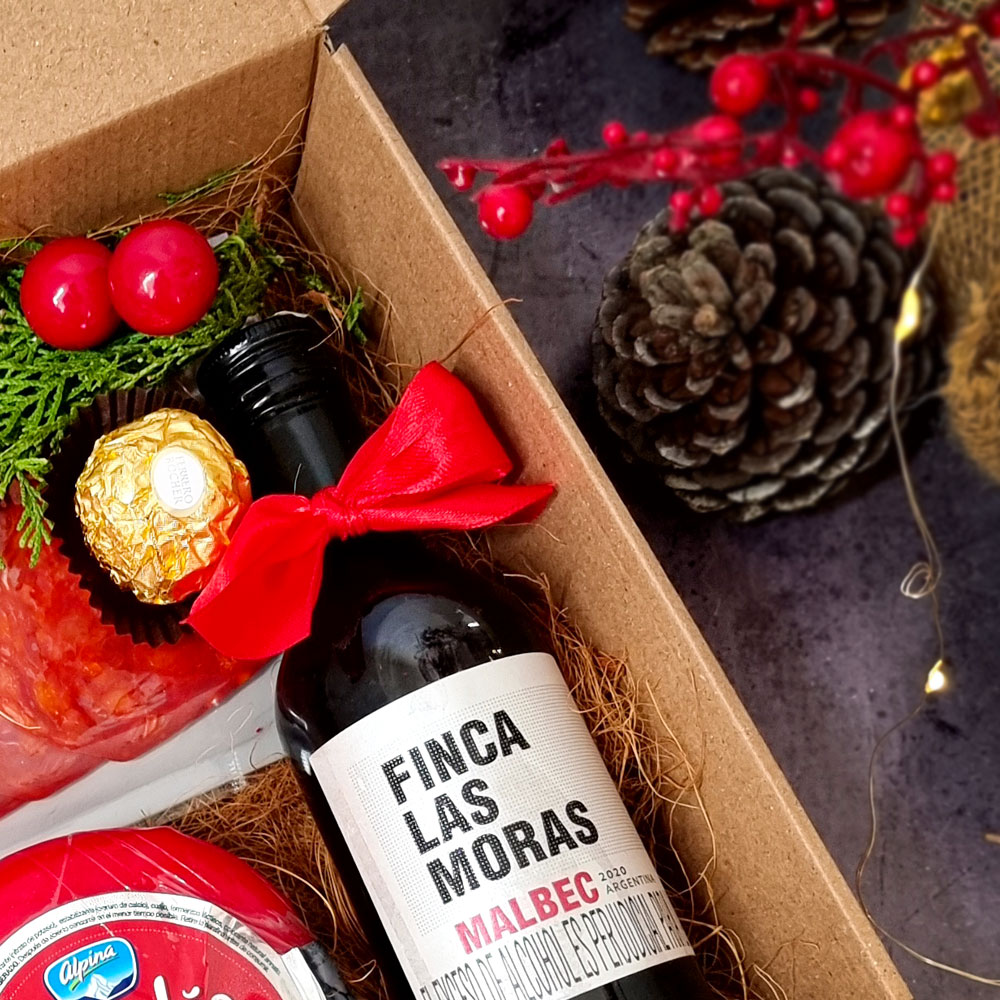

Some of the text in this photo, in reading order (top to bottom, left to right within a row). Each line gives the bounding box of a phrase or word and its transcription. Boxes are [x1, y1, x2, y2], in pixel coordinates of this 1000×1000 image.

[380, 709, 531, 806] FINCA
[402, 778, 500, 855] LAS
[426, 800, 600, 904] MORAS
[454, 871, 600, 954] MALBEC
[598, 866, 627, 882] 2020
[606, 873, 656, 895] ARGENTINA
[562, 915, 602, 976] ES
[581, 893, 671, 971] PERJUDICIAL
